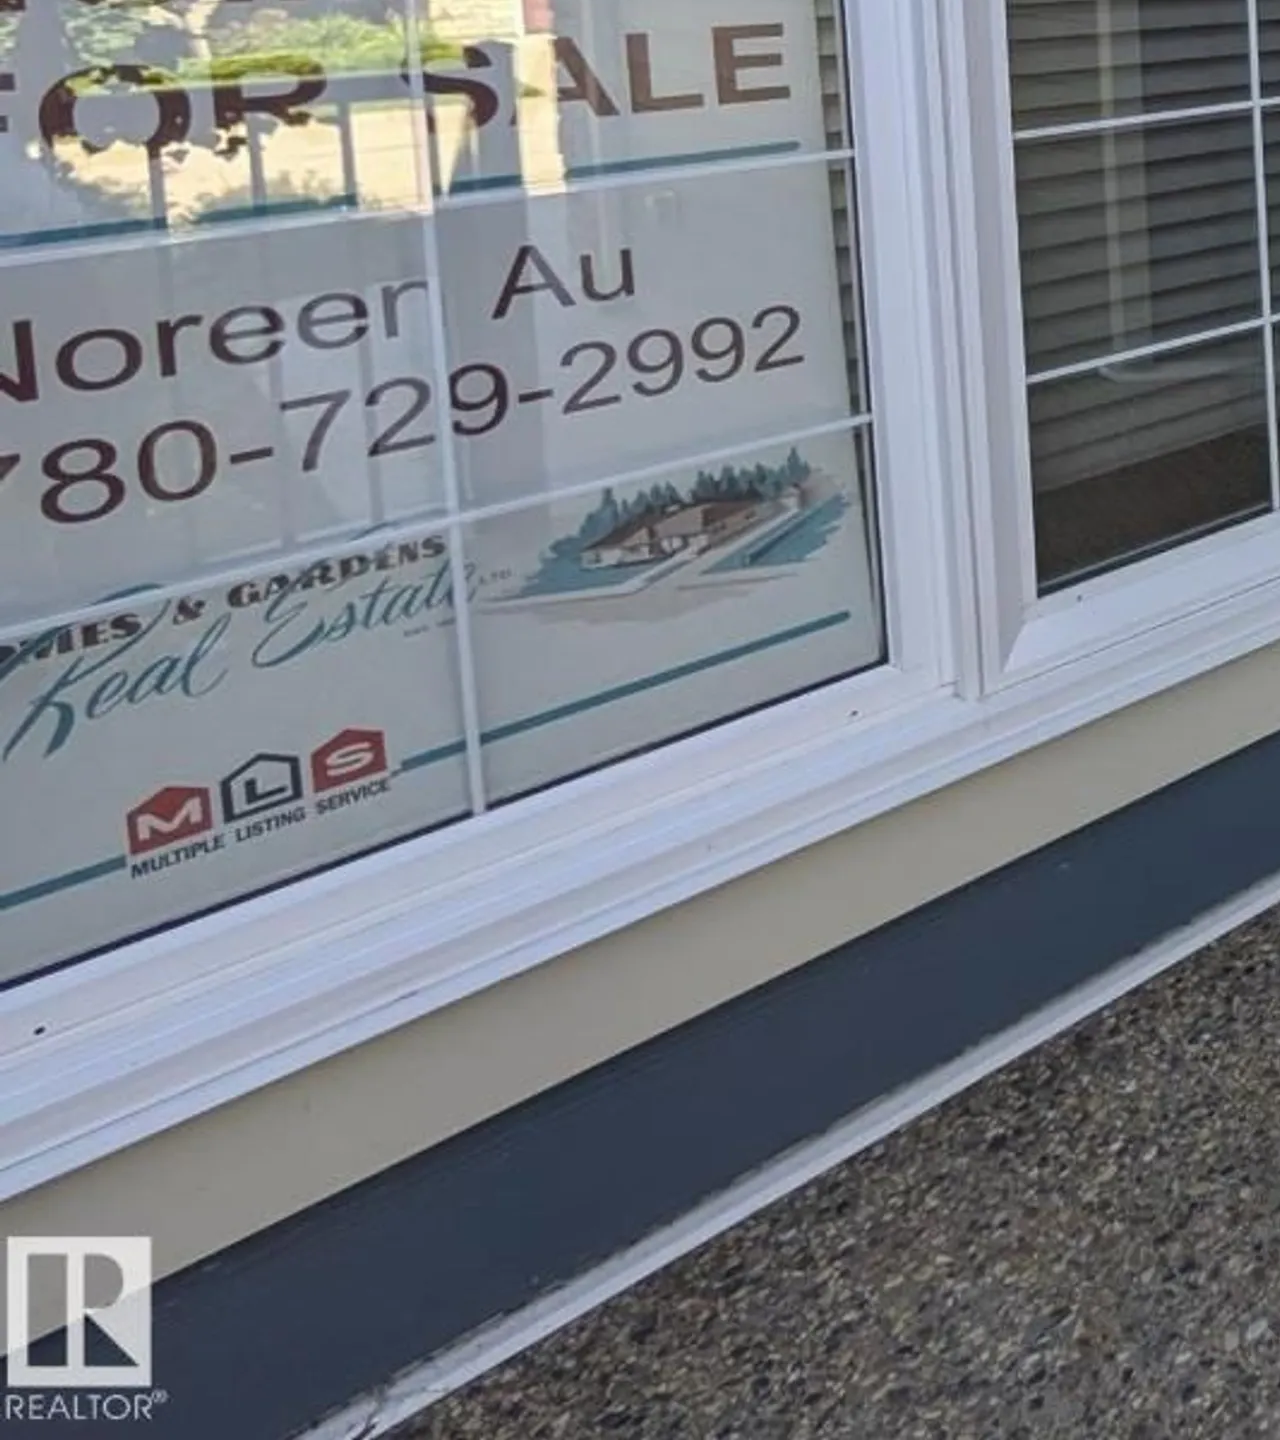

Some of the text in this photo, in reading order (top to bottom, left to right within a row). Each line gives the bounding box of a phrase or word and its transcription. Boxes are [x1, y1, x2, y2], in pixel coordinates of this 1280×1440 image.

[402, 22, 792, 137] SALE
[491, 244, 636, 321] Au
[172, 596, 207, 626] &
[227, 534, 447, 609] GARDENS
[2, 585, 233, 763] Real
[130, 776, 391, 879] MULTIPLE LISTING SERVICE
